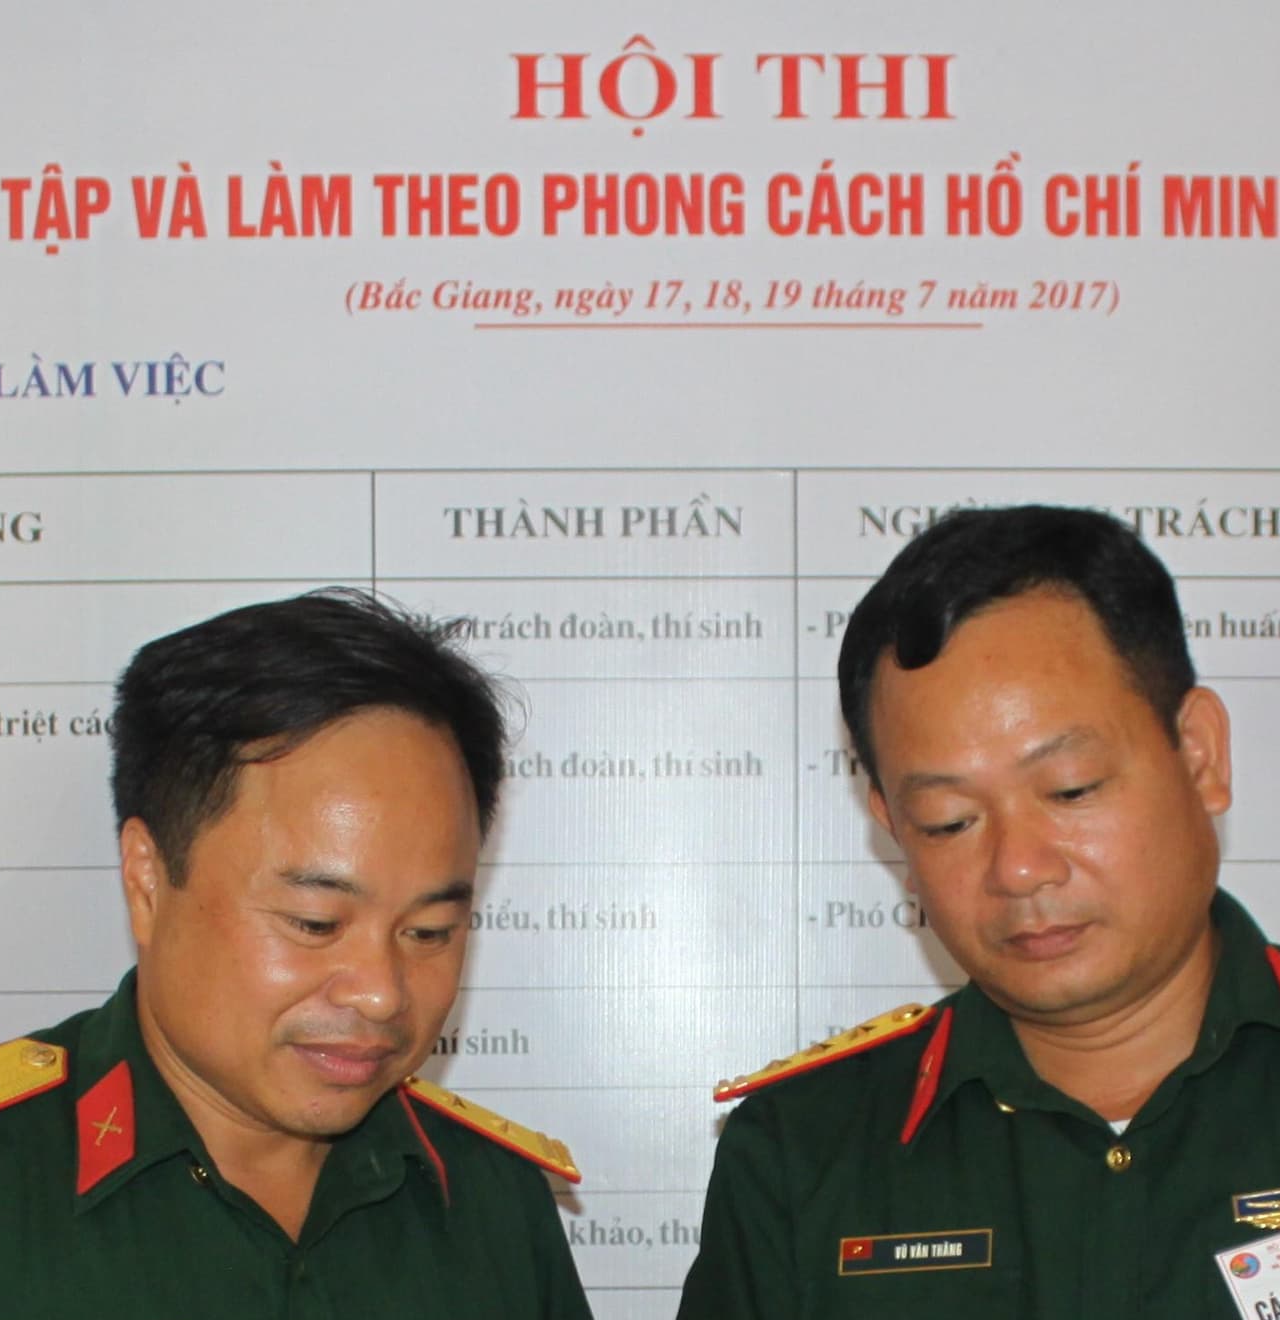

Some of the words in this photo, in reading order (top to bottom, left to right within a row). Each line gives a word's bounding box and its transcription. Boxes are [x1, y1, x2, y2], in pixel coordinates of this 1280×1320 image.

[509, 33, 723, 138] HỘI
[756, 53, 958, 121] THI
[0, 163, 112, 256] TẬP
[130, 161, 207, 240] VÀ
[228, 160, 352, 238] LÀM
[373, 172, 520, 237] THEO
[542, 172, 745, 237] PHONG
[766, 159, 924, 237] CÁCH
[946, 150, 1024, 238] HỒ
[1045, 160, 1141, 238] CHÍ
[345, 279, 422, 316] (Bắc
[432, 279, 543, 318] Giang,
[554, 281, 633, 316] ngày
[644, 281, 693, 316] 17,
[705, 281, 751, 316] 18,
[764, 281, 801, 311] 19
[811, 279, 907, 316] tháng
[918, 281, 936, 311] 7
[947, 284, 1017, 311] năm
[1029, 279, 1121, 316] 2017)
[112, 353, 226, 405] VIỆC
[444, 499, 604, 538] THÀNH
[621, 493, 743, 538] PHẦN
[471, 612, 551, 640] trách
[559, 612, 645, 641] đoàn,
[652, 611, 693, 640] thí
[700, 611, 762, 639] sinh
[561, 752, 646, 779] đoàn,
[701, 751, 762, 777] sinh
[596, 902, 657, 930] sinh
[827, 901, 884, 928] Phó
[466, 1028, 529, 1055] sinh
[570, 1217, 653, 1246] khảo,
